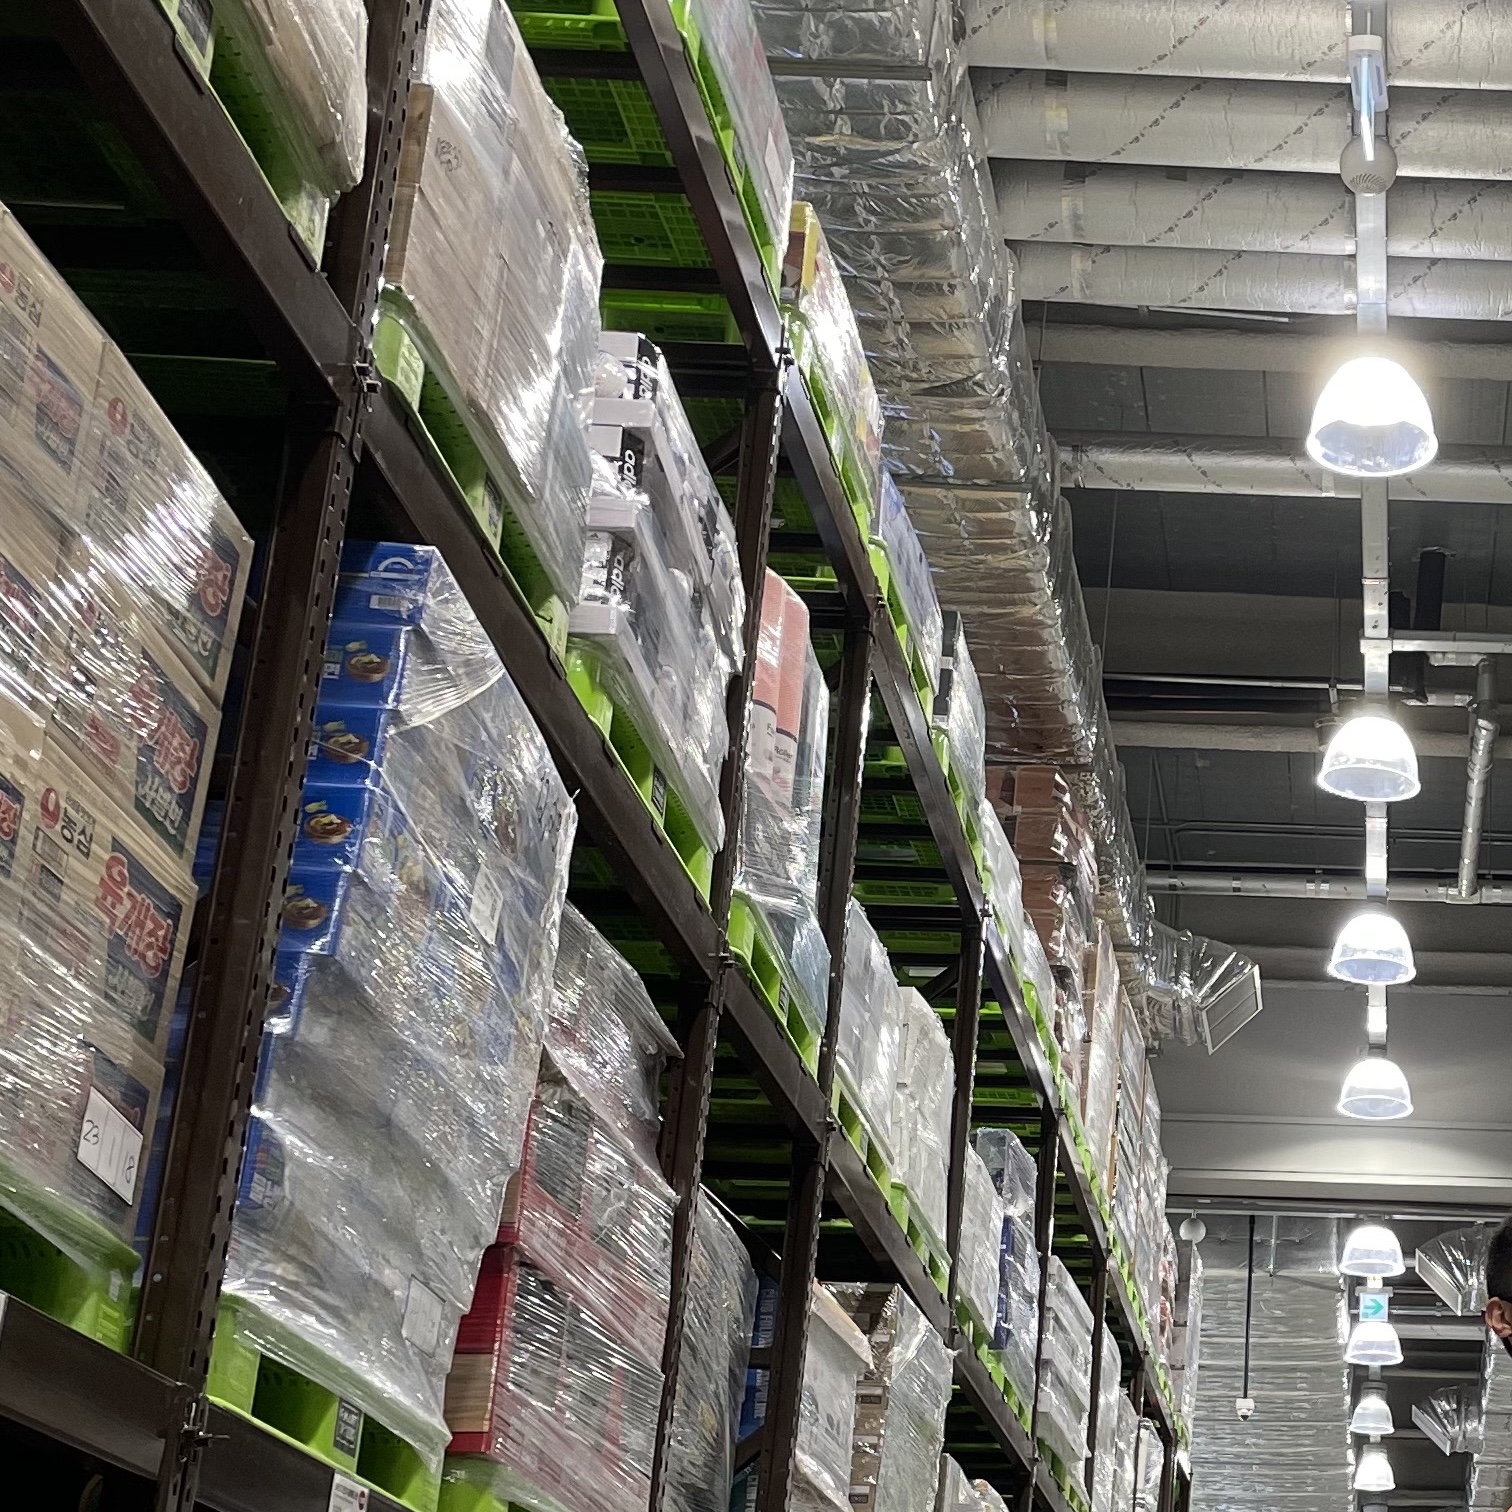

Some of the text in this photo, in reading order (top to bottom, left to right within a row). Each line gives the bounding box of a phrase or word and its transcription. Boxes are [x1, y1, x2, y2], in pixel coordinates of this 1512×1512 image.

[60, 806, 93, 860] 농심
[95, 852, 173, 978] 육개장
[82, 1119, 99, 1146] 23
